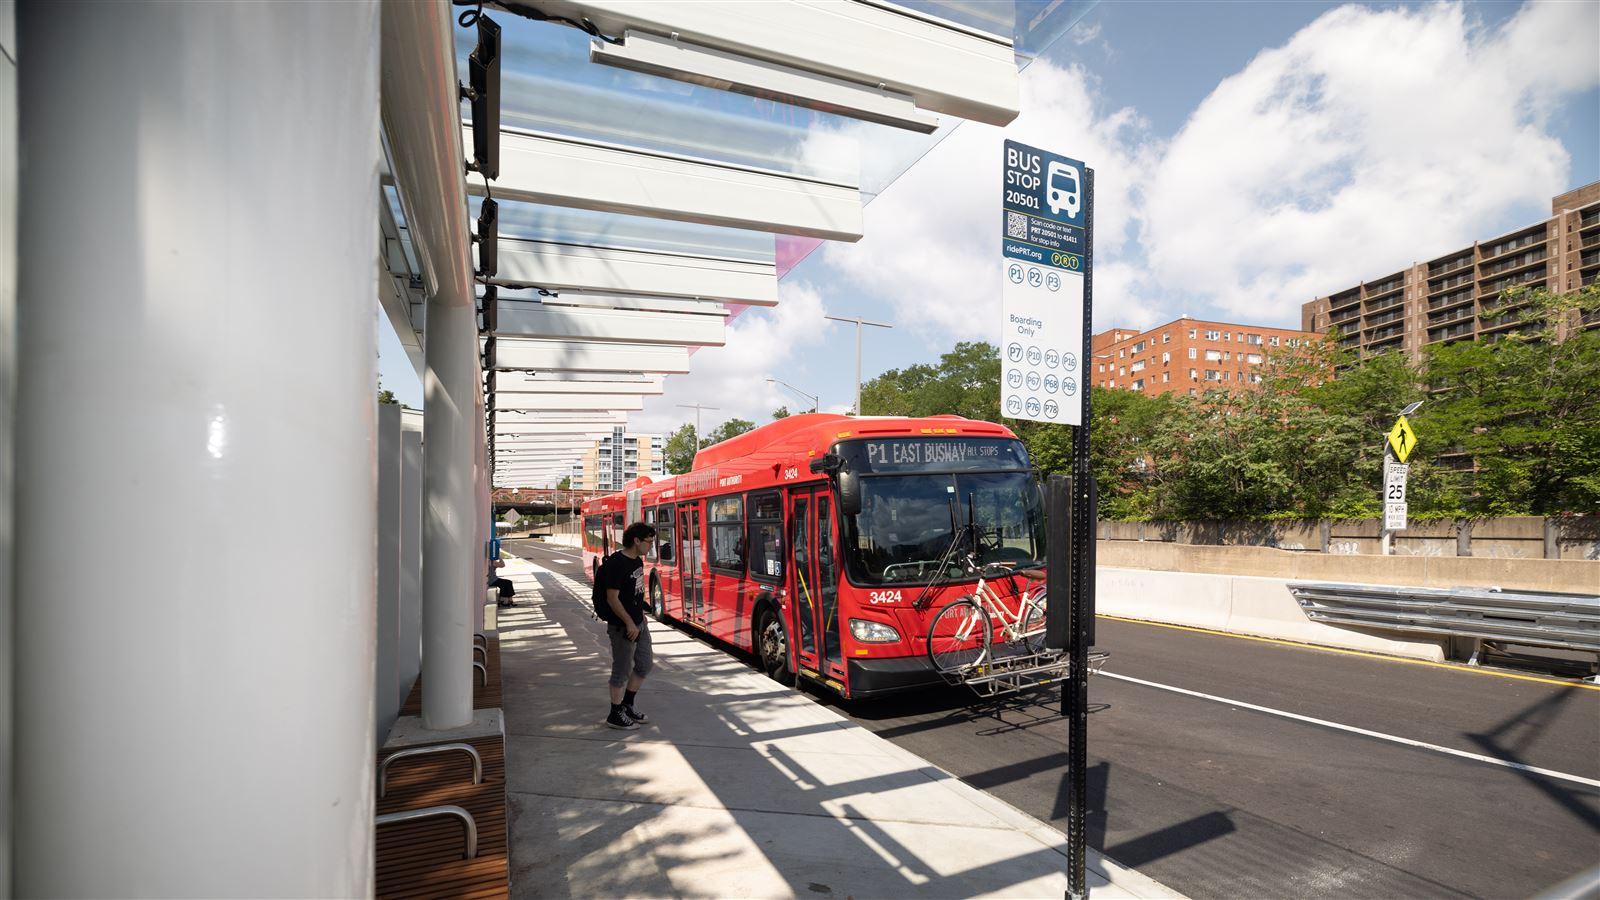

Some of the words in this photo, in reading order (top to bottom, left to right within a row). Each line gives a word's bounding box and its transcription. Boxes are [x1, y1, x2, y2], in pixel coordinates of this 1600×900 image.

[1008, 148, 1041, 174] BUS
[1007, 170, 1041, 190] STOP
[1006, 190, 1040, 209] 20501
[1031, 218, 1043, 226] Scan
[1043, 221, 1056, 230] code
[1031, 226, 1041, 234] PRT
[1041, 229, 1057, 238] 20501
[1063, 234, 1077, 243] 41411
[1006, 245, 1042, 260] ridePRT.org
[1010, 314, 1042, 329] Boarding
[1018, 325, 1035, 337] Only
[867, 444, 889, 463] P1
[893, 443, 921, 463] EAST
[925, 443, 967, 462] BUSWAY
[967, 446, 978, 456] ALL
[980, 446, 999, 456] STOPS
[785, 468, 798, 480] 3424
[1390, 466, 1406, 474] SPEED
[1388, 485, 1403, 500] 25
[870, 590, 902, 604] 3424
